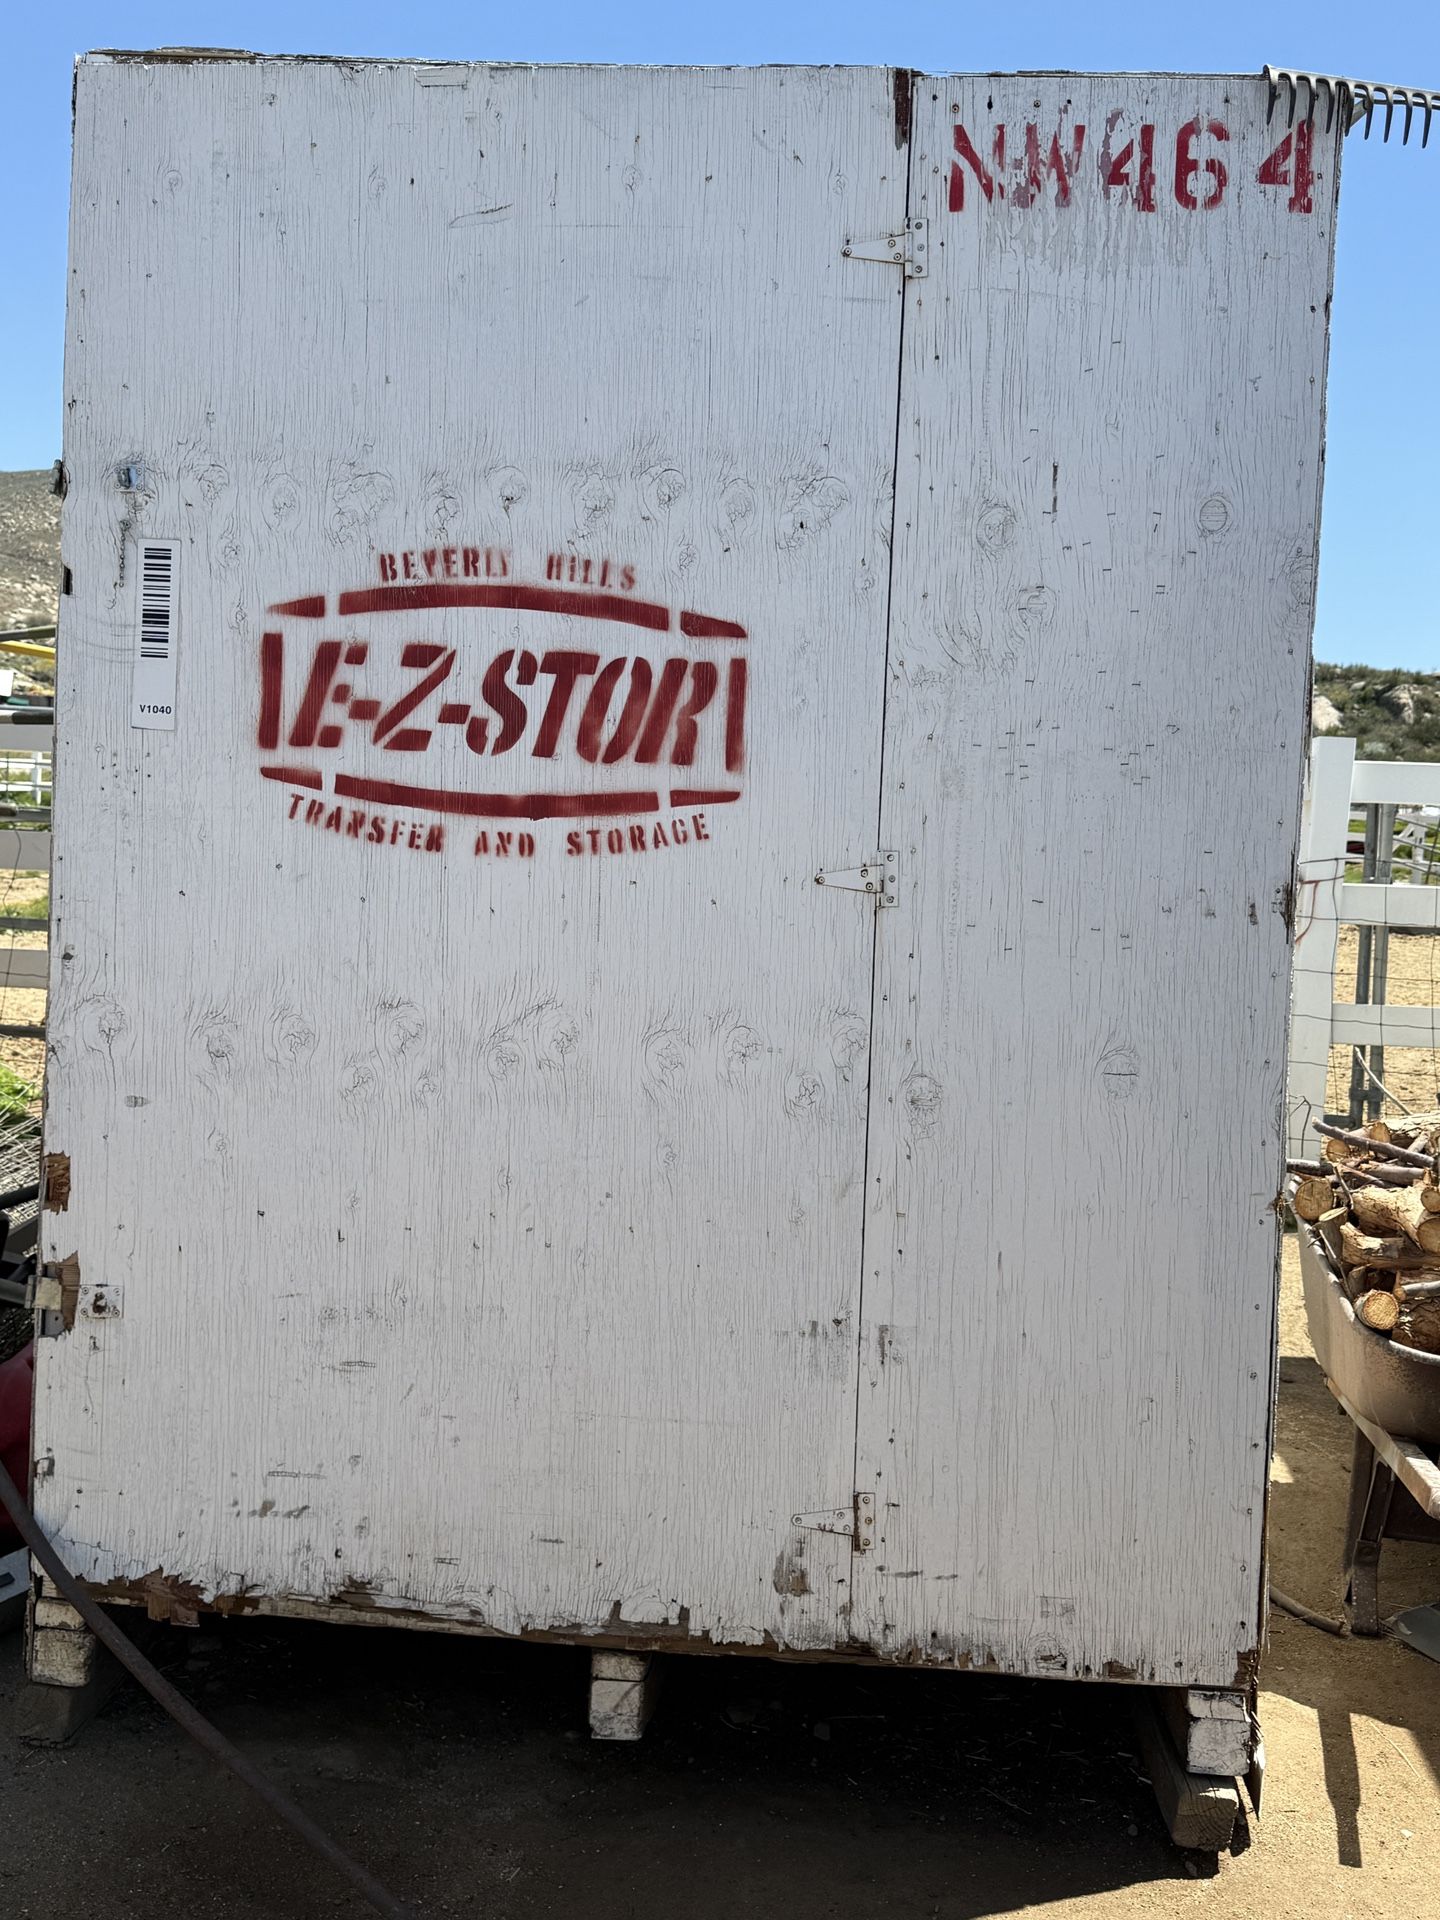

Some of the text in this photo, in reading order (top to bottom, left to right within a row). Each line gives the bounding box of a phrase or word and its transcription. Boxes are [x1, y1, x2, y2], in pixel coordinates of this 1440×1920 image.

[379, 546, 637, 591] BEVERLY HILLS
[138, 704, 173, 715] V1040
[288, 640, 718, 766] E-Z-STOR
[288, 793, 711, 858] TRANSFER AND STORAGE
